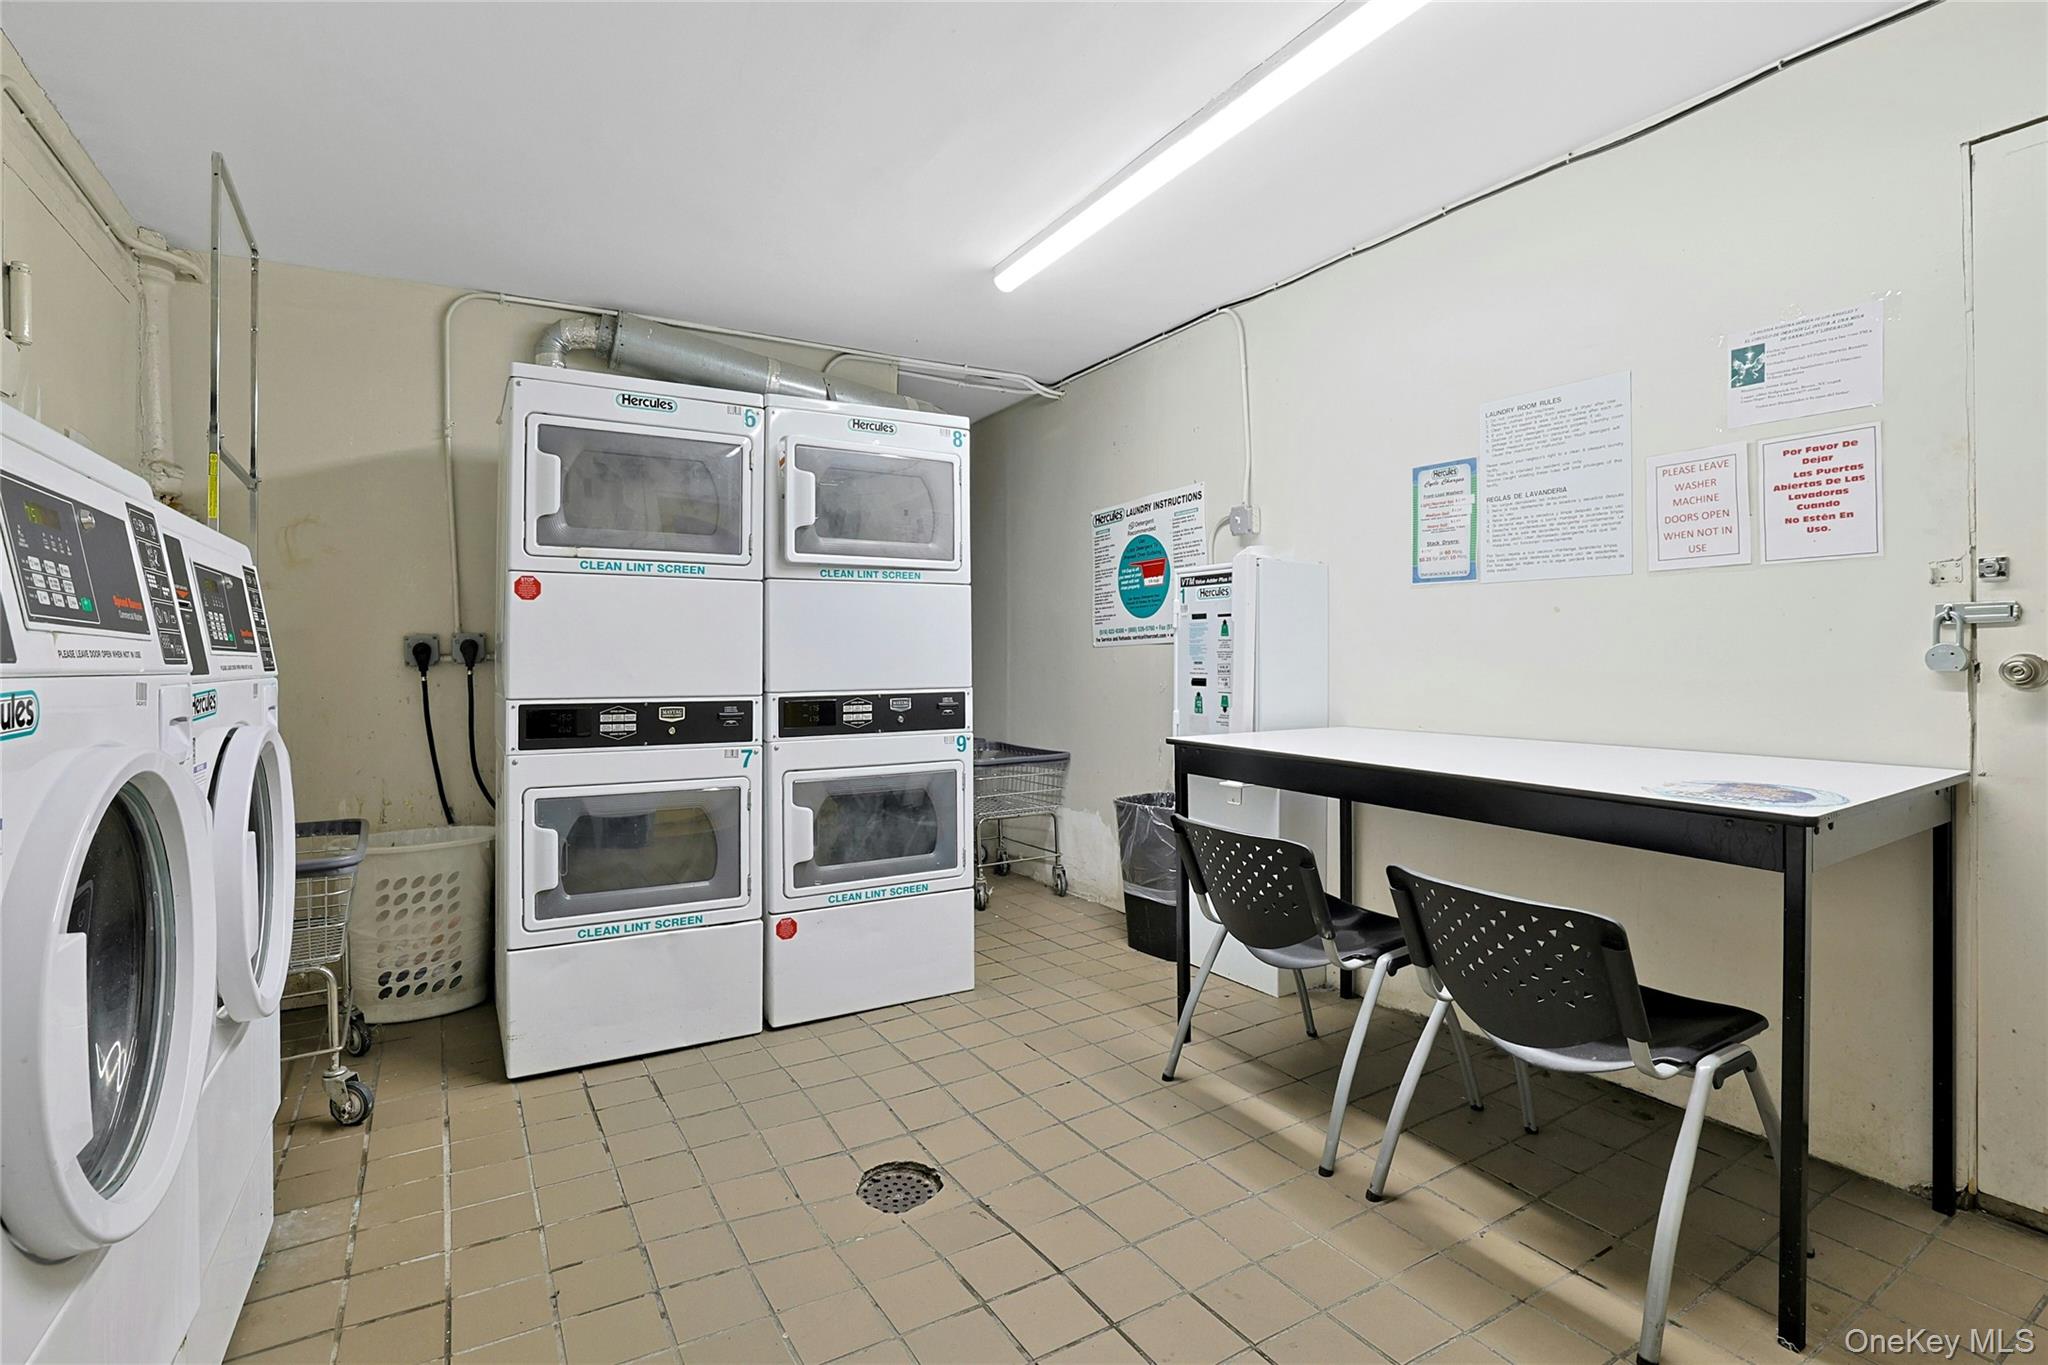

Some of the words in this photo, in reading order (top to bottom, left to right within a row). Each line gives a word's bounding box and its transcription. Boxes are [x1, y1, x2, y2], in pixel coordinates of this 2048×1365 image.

[621, 394, 674, 411] Hercules
[1485, 406, 1515, 418] LAUNDRY
[1517, 402, 1537, 412] ROOM
[1540, 396, 1562, 406] RULES
[744, 409, 756, 428] 6
[852, 418, 894, 433] Hercules
[953, 430, 962, 448] 8
[1783, 448, 1802, 456] Por
[1805, 442, 1839, 454] Favor
[1802, 455, 1834, 465] Dejar
[1433, 468, 1457, 478] Hercules
[1662, 464, 1696, 478] PLEASE
[1699, 459, 1729, 472] LEAVE
[1794, 470, 1812, 478] Las
[1816, 464, 1864, 476] Puertas
[1674, 478, 1717, 492] WASHER
[1773, 480, 1822, 492] Abiertas
[1826, 477, 1841, 485] De
[1845, 474, 1865, 483] Las
[1486, 494, 1511, 504] REGLAS
[1525, 486, 1568, 498] LAVANDERIA
[1672, 494, 1720, 506] MACHINE
[1788, 488, 1849, 500] Lavadoras
[1094, 510, 1123, 525] Hercules
[1126, 503, 1152, 517] LAUNDRY
[1153, 490, 1203, 510] INSTRUCTIONS
[1796, 500, 1840, 510] Cuando
[1664, 512, 1699, 524] DOORS
[1702, 509, 1730, 520] OPEN
[1803, 513, 1836, 523] Estén
[1664, 530, 1694, 541] WHEN
[1697, 526, 1719, 537] NOT
[1722, 526, 1732, 534] IN
[1807, 526, 1831, 534] Uso.
[1688, 544, 1707, 554] USE
[580, 560, 622, 572] CLEAN
[626, 562, 653, 572] LINT
[657, 564, 705, 575] SCREEN
[820, 568, 854, 578] CLEAN
[857, 570, 879, 578] LINT
[882, 570, 921, 580] SCREEN
[1182, 577, 1196, 586] VTM
[1180, 588, 1185, 604] 1
[1200, 586, 1230, 598] Hercules
[58, 650, 76, 658] PLEASE
[76, 650, 90, 658] LEAVE
[89, 650, 100, 658] DOOR
[101, 650, 112, 658] OPEN
[956, 736, 968, 752] 9
[740, 750, 753, 768] 7
[828, 892, 864, 904] CLEAN
[864, 889, 888, 900] LINT
[890, 883, 929, 897] SCREEN
[577, 923, 620, 940] CLEAN
[623, 920, 652, 934] LINT
[654, 914, 704, 930] SCREEN
